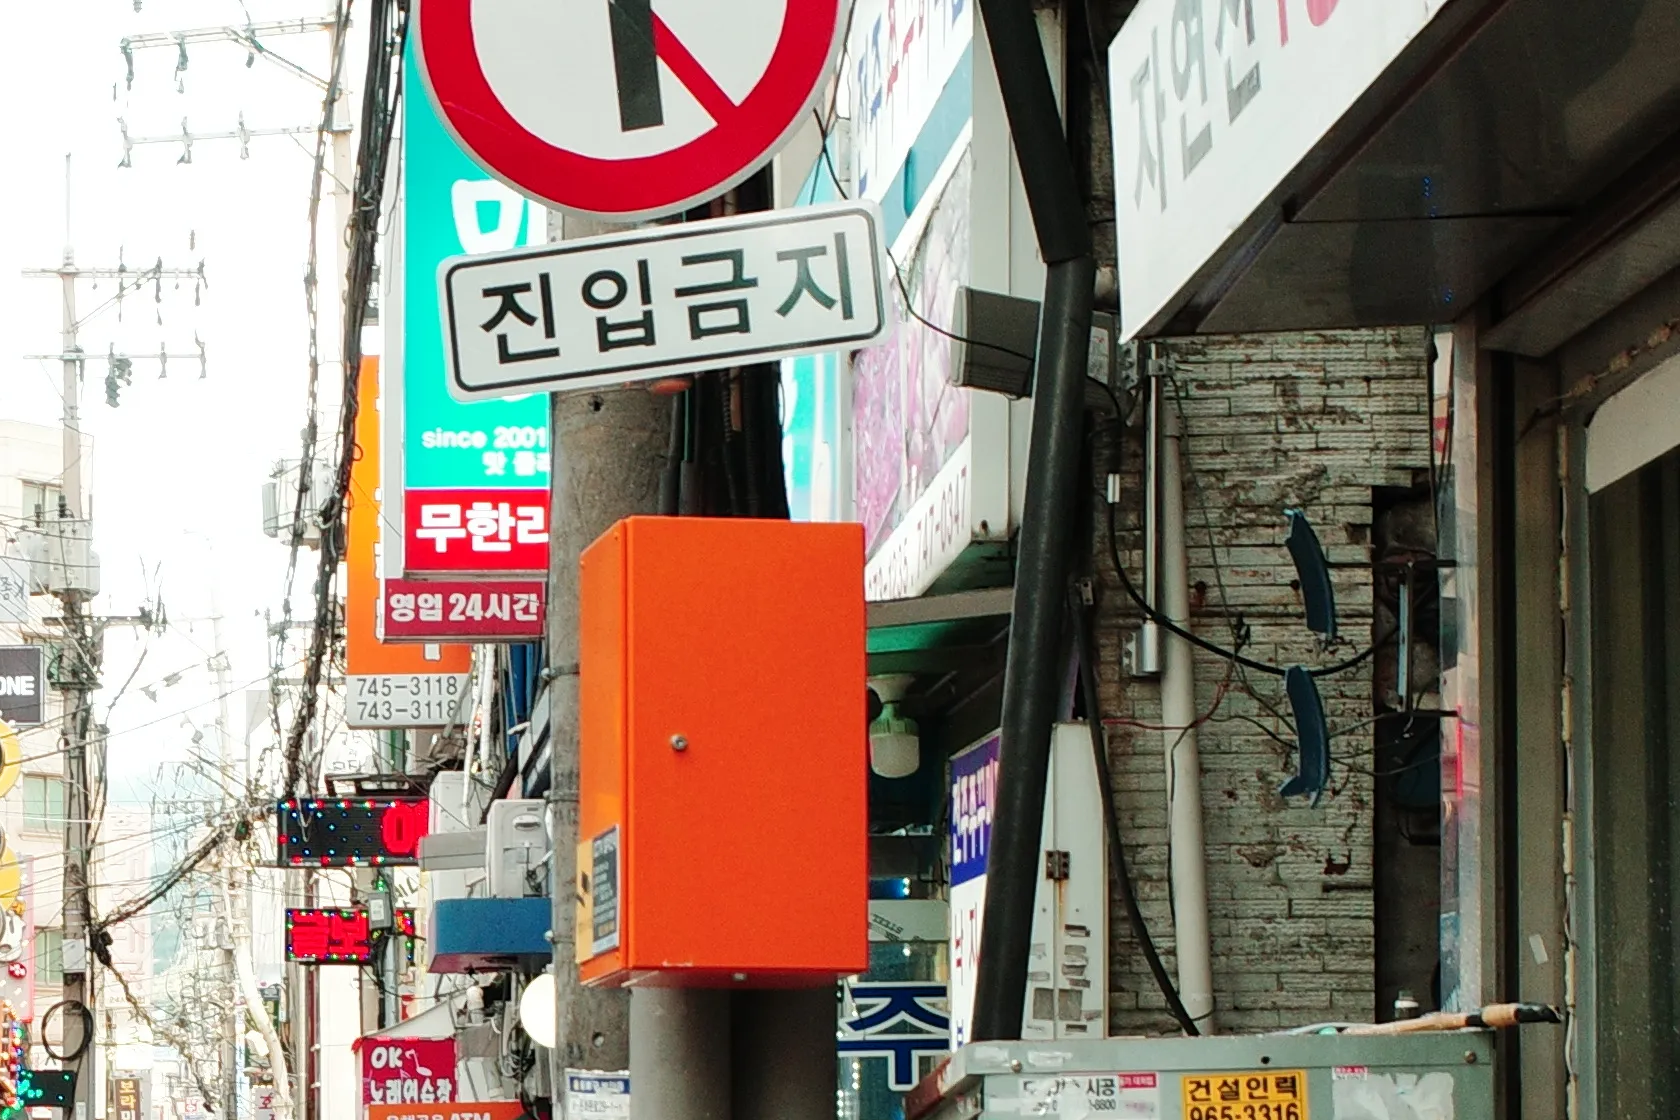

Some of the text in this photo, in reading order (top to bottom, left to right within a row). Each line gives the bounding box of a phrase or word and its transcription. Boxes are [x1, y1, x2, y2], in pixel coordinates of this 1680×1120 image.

[478, 230, 857, 366] 진입금지
[421, 425, 547, 449] since 2001
[388, 592, 540, 623] 영업 24시간
[356, 676, 459, 697] 745-3118
[356, 700, 458, 721] 743-3118
[370, 1046, 404, 1070] OK
[1188, 1074, 1300, 1102] 건설인력
